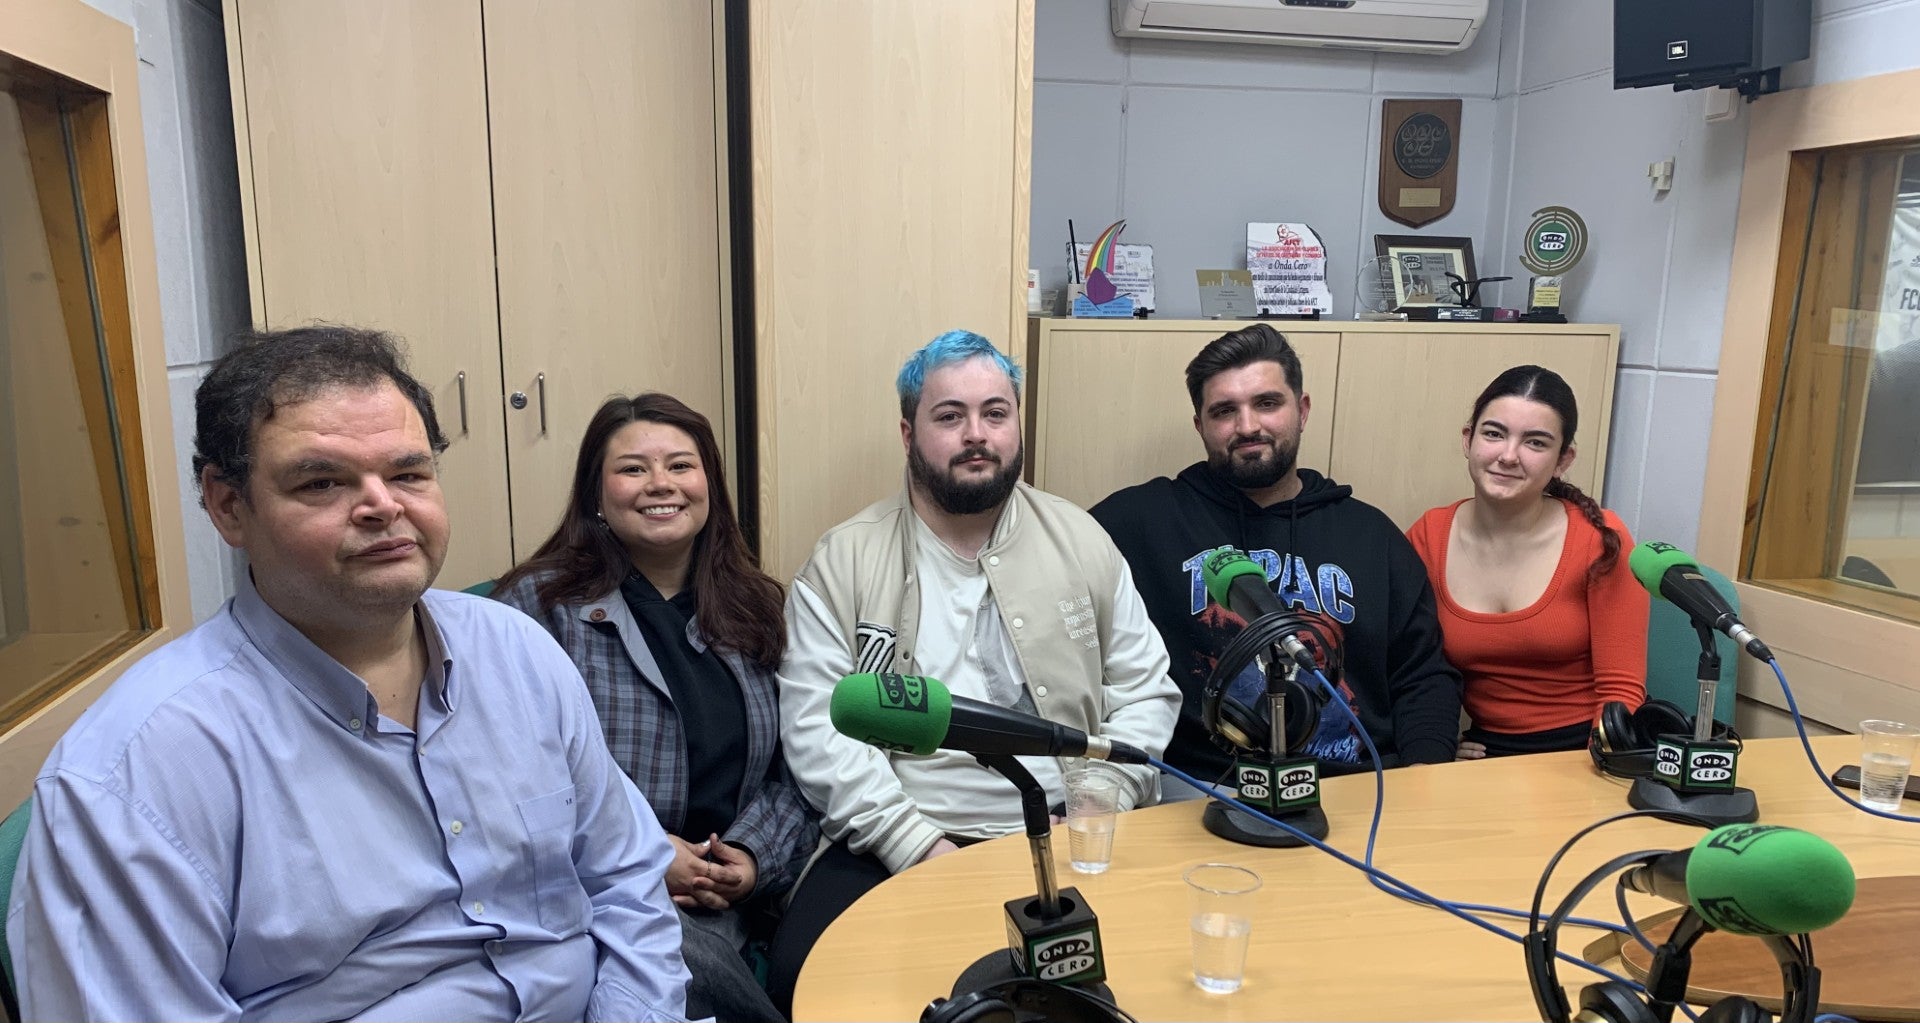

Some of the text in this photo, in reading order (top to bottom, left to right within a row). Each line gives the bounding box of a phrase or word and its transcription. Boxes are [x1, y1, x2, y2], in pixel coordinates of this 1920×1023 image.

[1671, 46, 1685, 55] JBL
[1274, 259, 1292, 270] Onda
[1294, 259, 1308, 270] Cero
[1899, 287, 1920, 310] FC
[1183, 545, 1356, 624] TPAC
[1660, 750, 1679, 761] ONDA
[1660, 763, 1677, 774] CERO
[1696, 770, 1726, 778] CERO
[1242, 773, 1265, 783] ONDA
[1282, 773, 1311, 784] ONDA
[1244, 786, 1266, 796] CERO
[1285, 786, 1311, 797] CERO
[1042, 941, 1086, 960] ONDA
[1047, 958, 1088, 976] CERO
